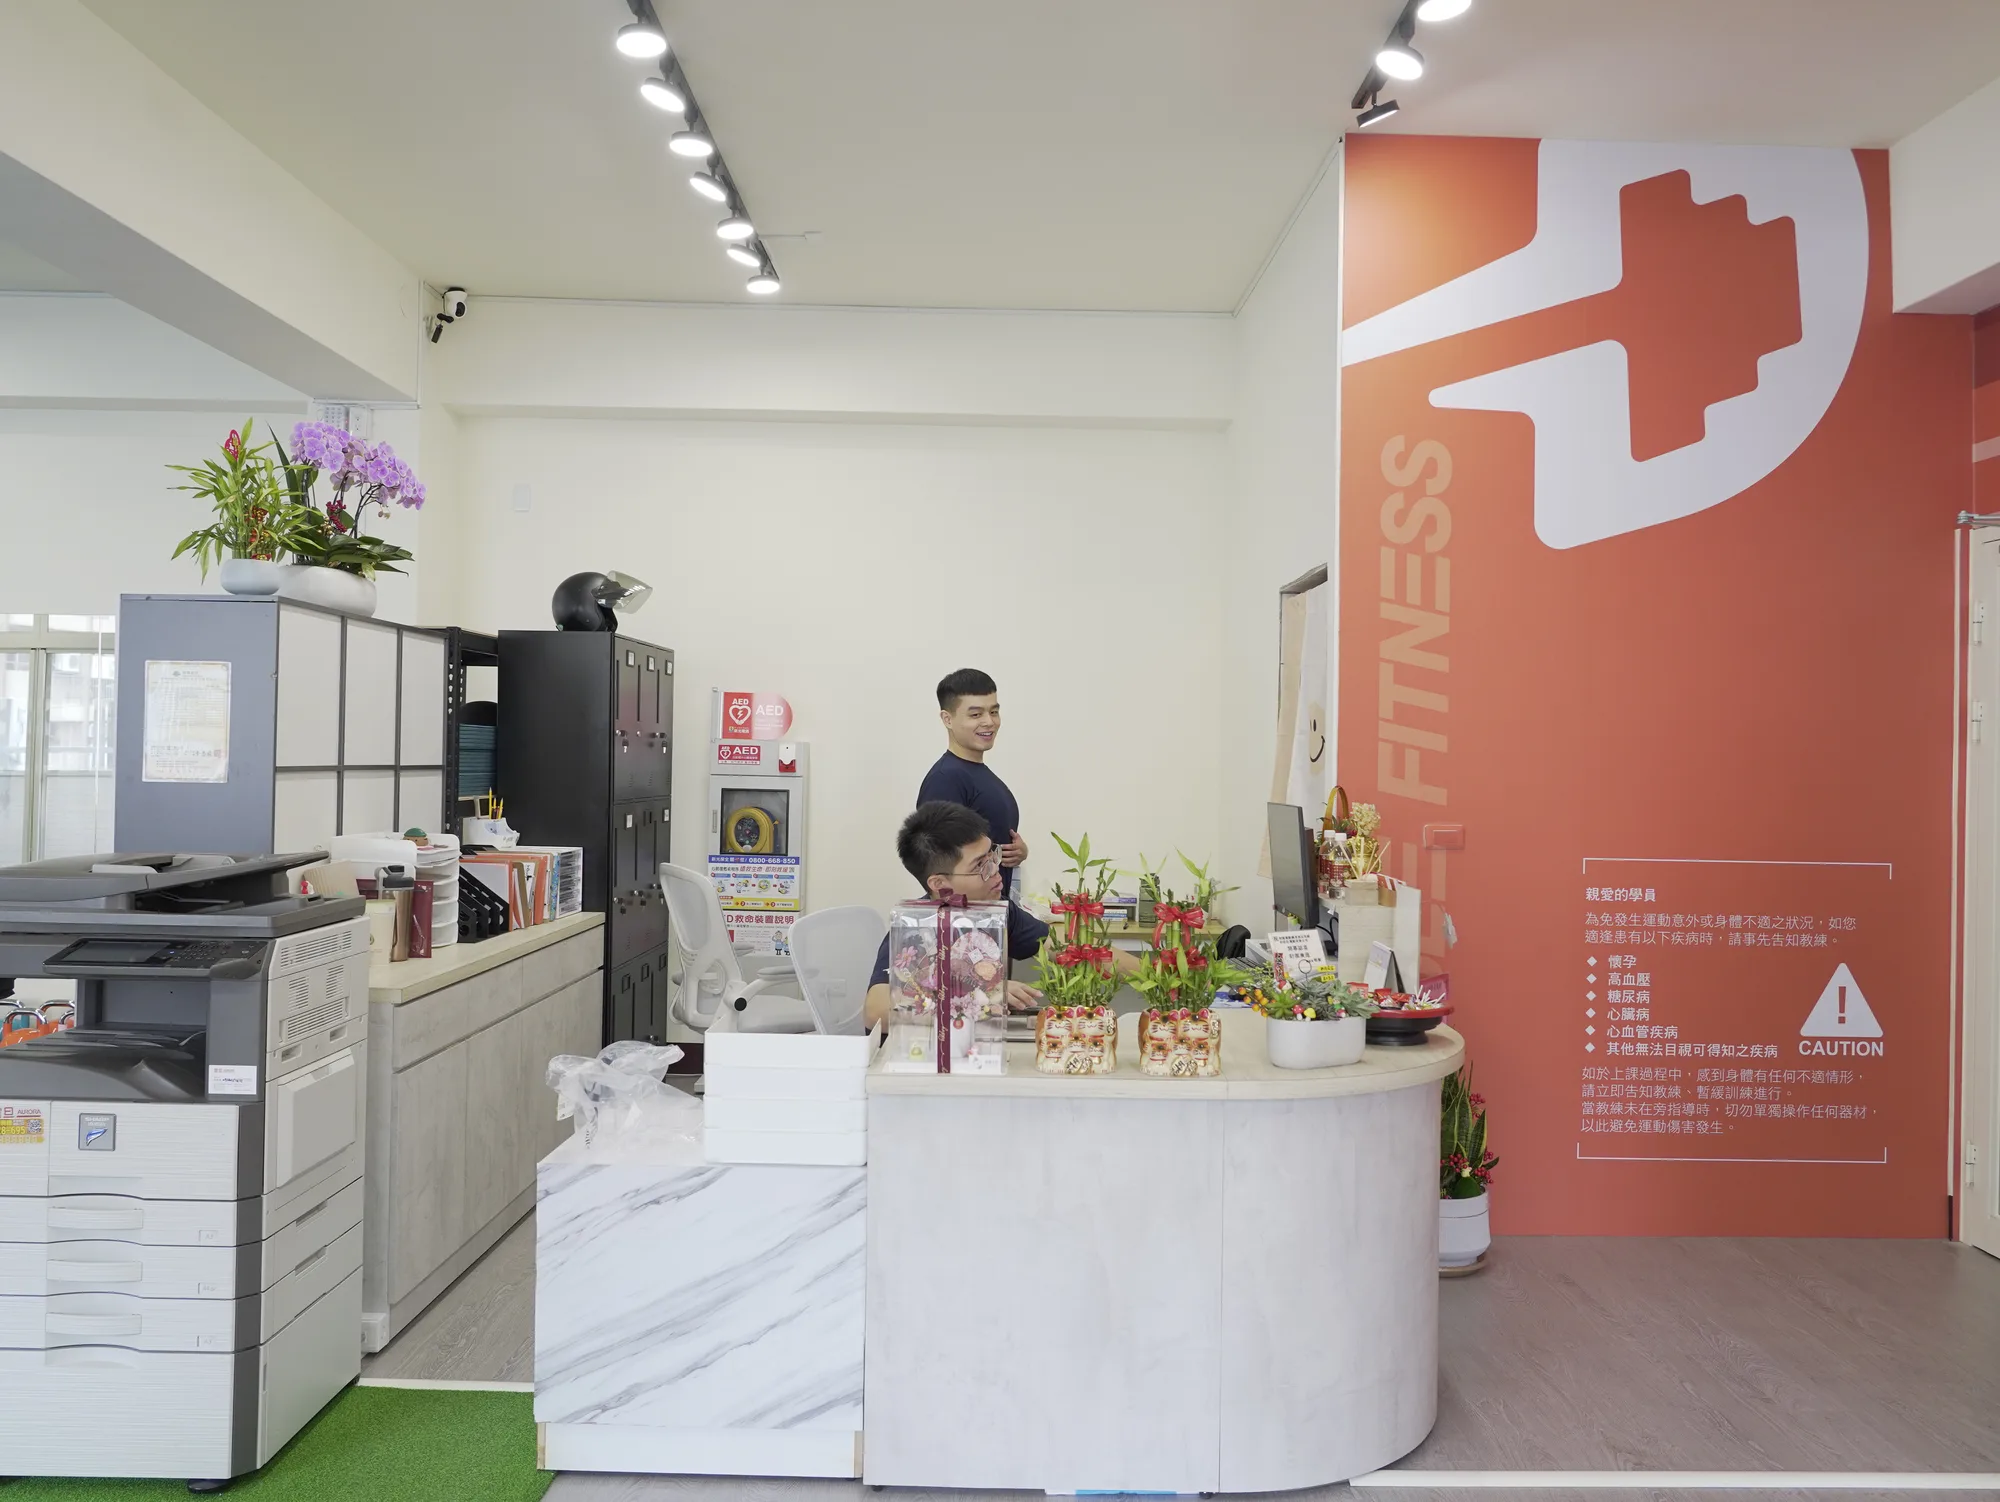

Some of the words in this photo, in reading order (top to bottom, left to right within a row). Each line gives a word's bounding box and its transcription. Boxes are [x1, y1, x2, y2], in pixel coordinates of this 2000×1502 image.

[1378, 434, 1453, 806] FITNESS
[755, 705, 784, 716] AED
[733, 746, 759, 755] AED
[1585, 887, 1657, 902] 親愛的學員
[725, 915, 795, 924] D救命裝置說明
[1584, 912, 1857, 931] 為免發生運動意外或身體不適之狀況，如您
[1584, 930, 1840, 948] 適逢患有以下疾病時，請事先告知教練。
[1608, 954, 1637, 969] 懷孕
[1607, 972, 1651, 987] 高血壓
[1607, 989, 1651, 1004] 糖尿病
[1607, 1007, 1651, 1021] 心臟病
[1606, 1024, 1679, 1039] 心血管疾病
[1606, 1042, 1779, 1058] 其他無法目視可得知之疾病
[1798, 1040, 1884, 1057] CAUTION
[0, 1126, 26, 1135] 8-695
[1580, 1118, 1737, 1136] 以此避免運動傷害發生。
